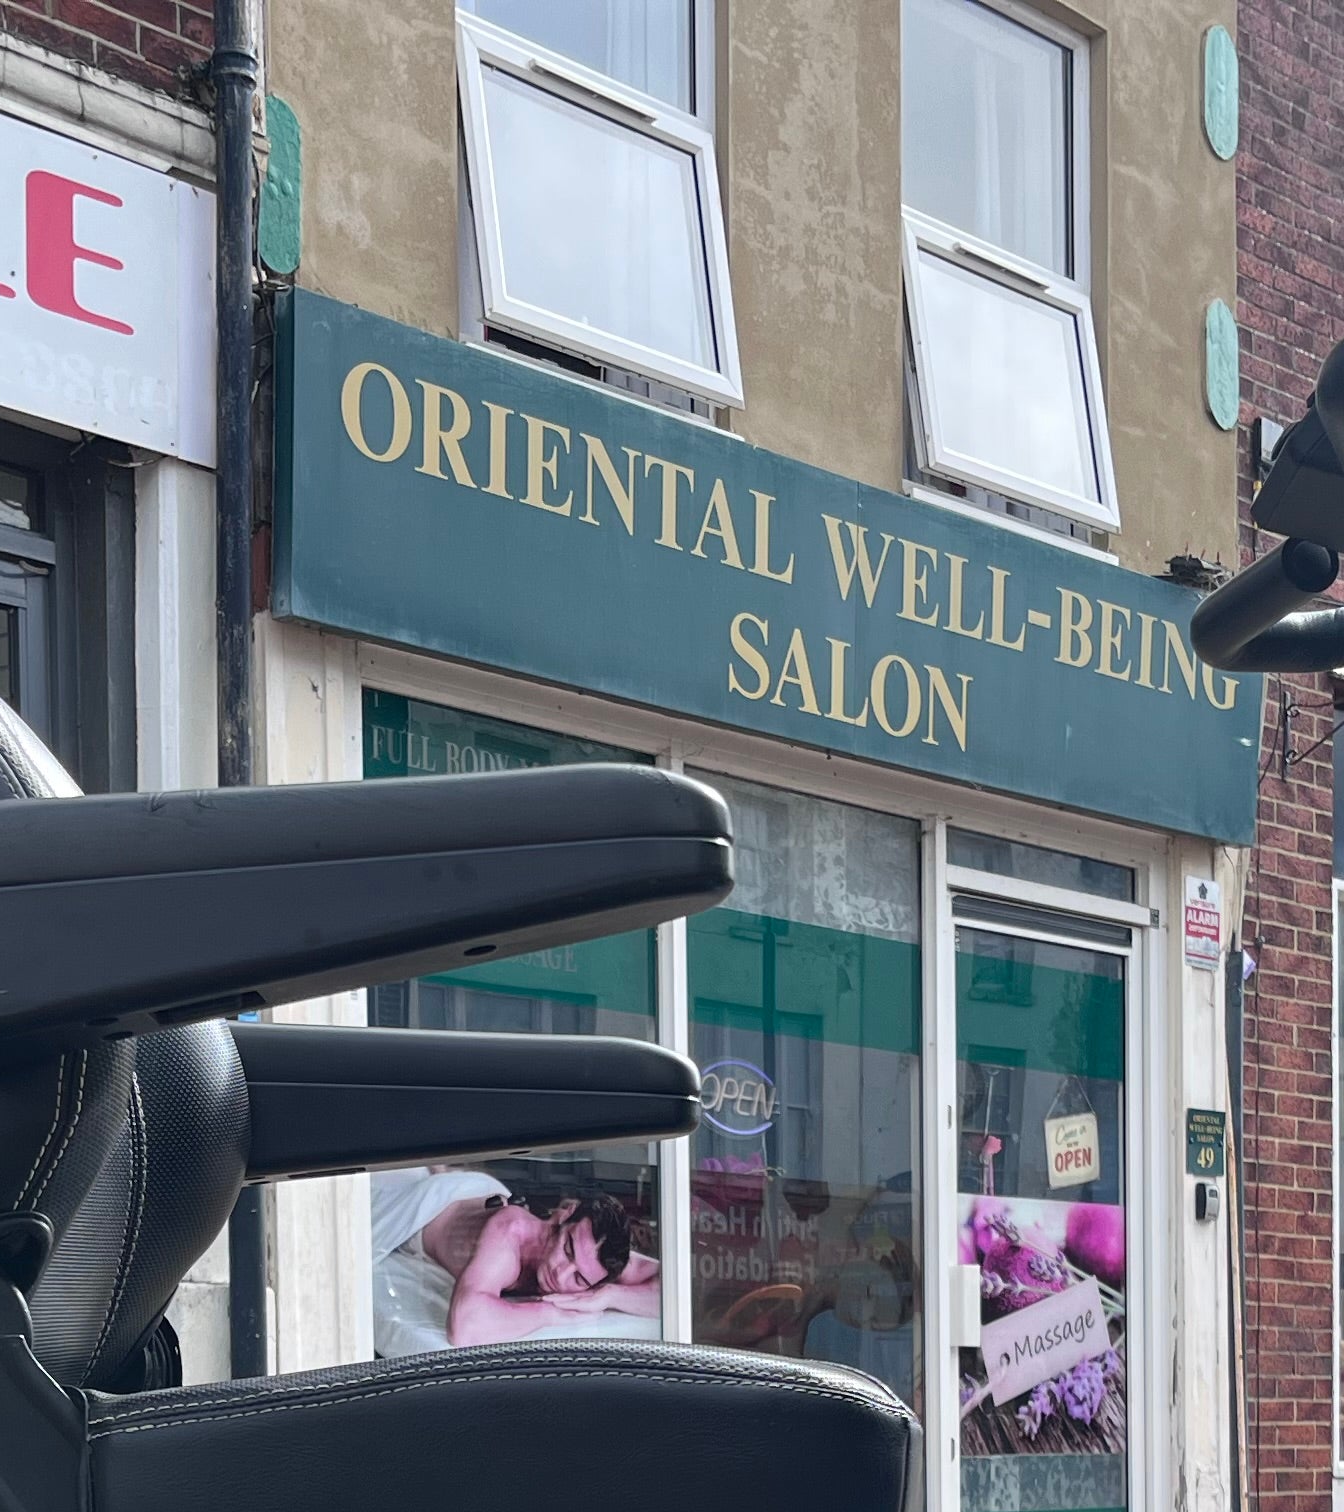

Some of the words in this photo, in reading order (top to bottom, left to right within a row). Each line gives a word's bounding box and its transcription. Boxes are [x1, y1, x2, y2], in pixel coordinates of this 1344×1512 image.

[340, 362, 795, 585] ORIENTAL
[821, 512, 1239, 711] WELL-BEING
[728, 612, 973, 753] SALON
[371, 724, 437, 772] FULL
[1187, 908, 1219, 928] ALARM
[700, 1072, 776, 1121] OPEN
[1054, 1146, 1092, 1173] OPEN
[1197, 1146, 1215, 1169] 49
[1013, 1308, 1096, 1367] Massage
